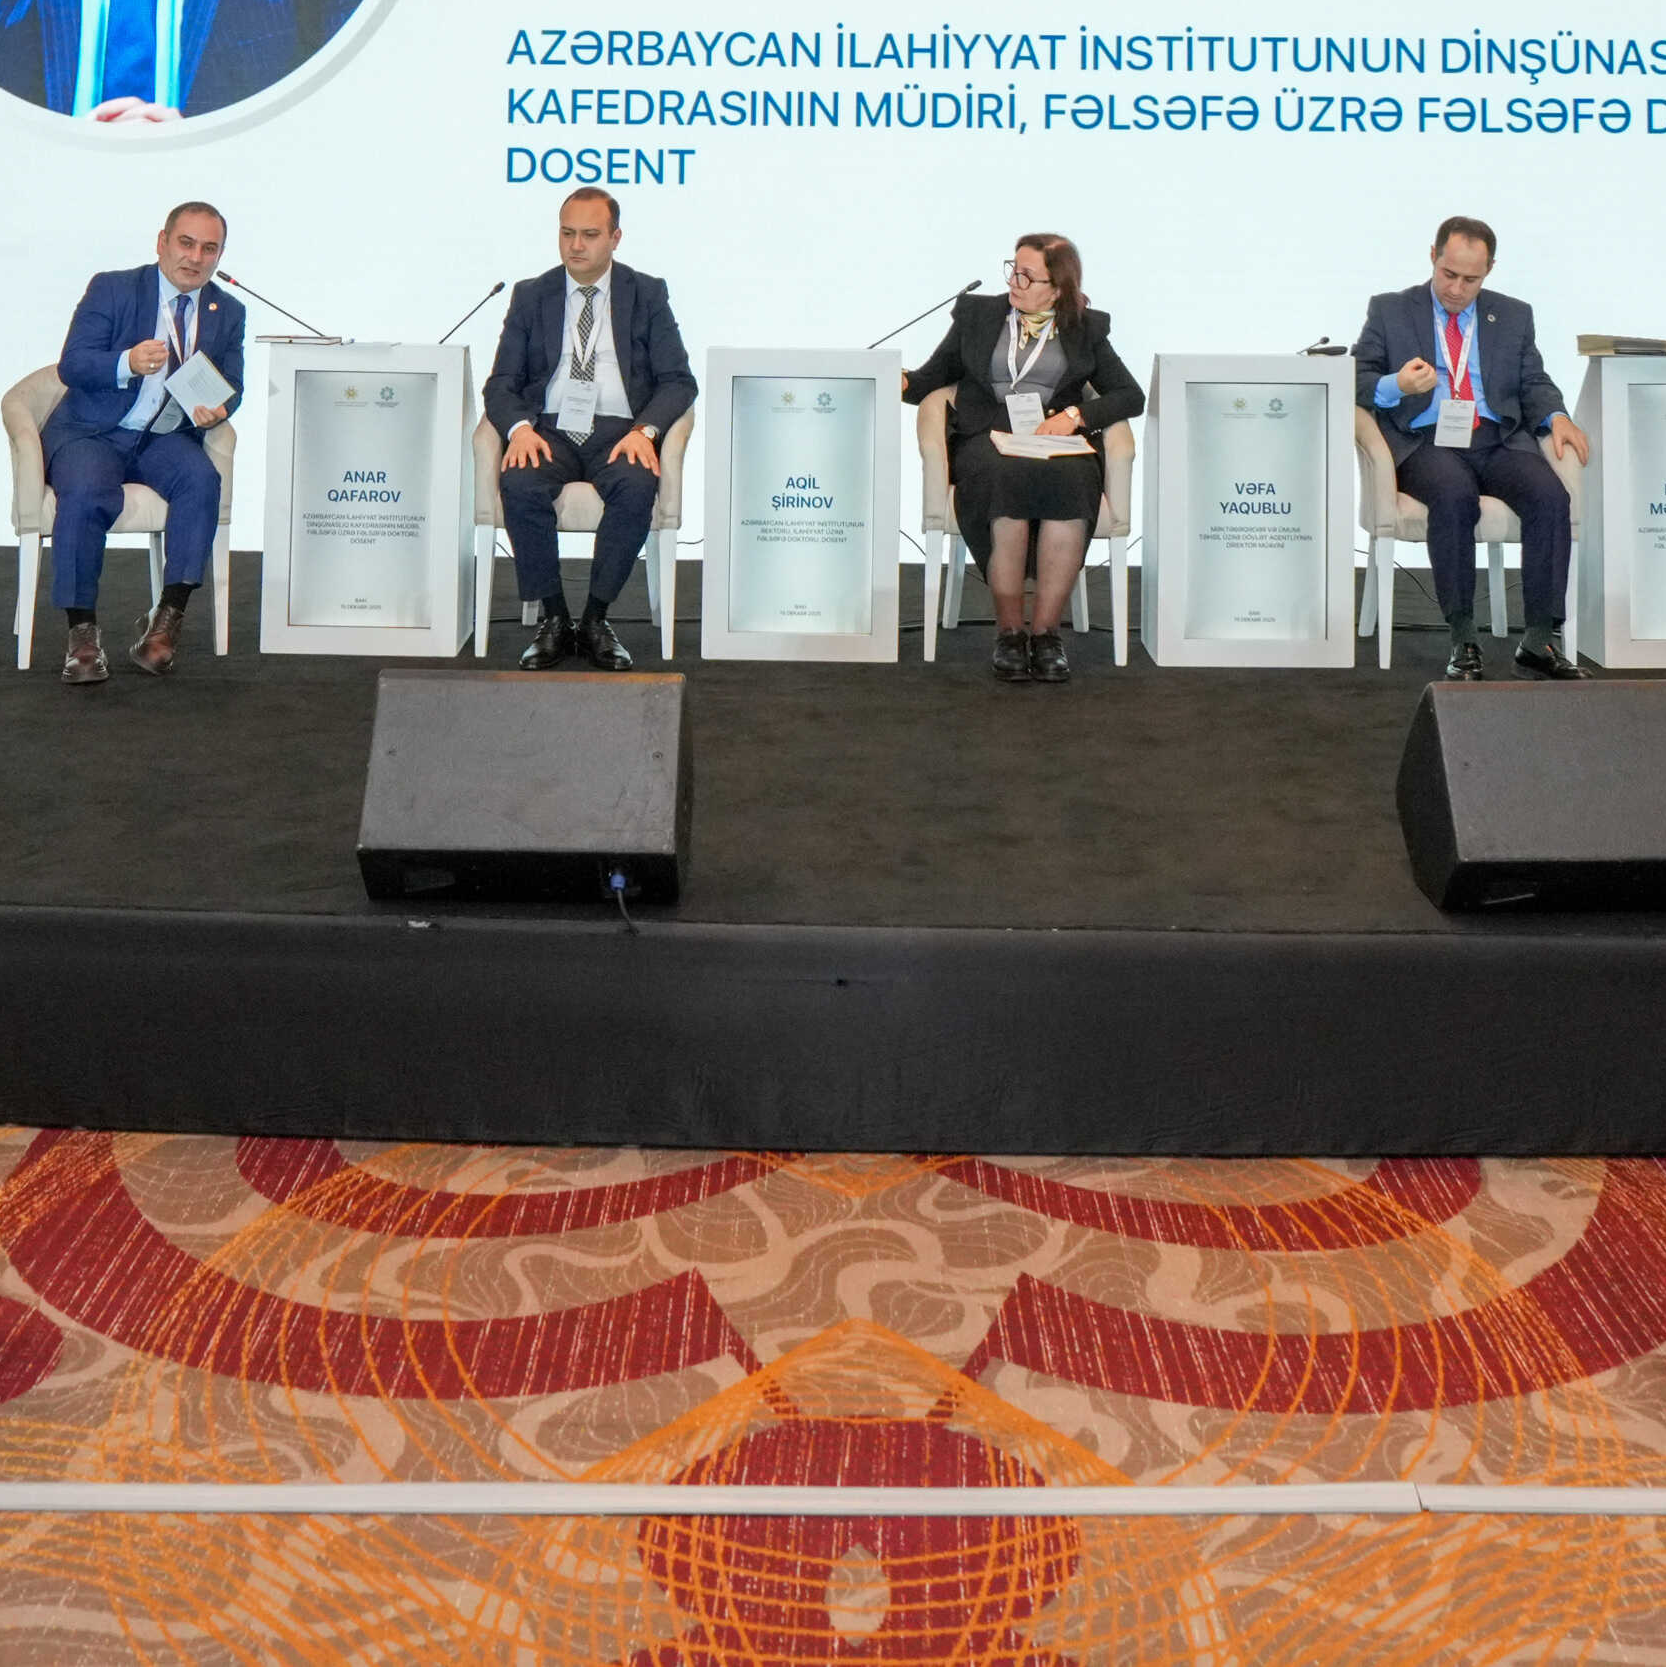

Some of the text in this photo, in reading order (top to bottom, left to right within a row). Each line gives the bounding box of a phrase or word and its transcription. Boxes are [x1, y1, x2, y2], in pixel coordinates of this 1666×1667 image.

[506, 29, 821, 67] AZƏRBAYCAN
[836, 22, 1067, 70] İLAHİYYAT
[1079, 25, 1426, 73] İNSTİTUTUNUN
[507, 88, 840, 127] KAFEDRASININ
[855, 82, 1028, 135] MÜDİRİ,
[1044, 94, 1260, 131] FƏLSƏFƏ
[1274, 87, 1404, 132] ÜZRƏ
[1418, 97, 1632, 134] FƏLSƏFƏ
[506, 147, 697, 184] DOSENT
[343, 471, 386, 484] ANAR
[785, 474, 820, 491] AQİL
[327, 489, 401, 503] QAFAROV
[1235, 482, 1276, 495] VƏFA
[771, 493, 833, 511] ŞİRİNOV
[1220, 501, 1291, 515] YAQUBLU
